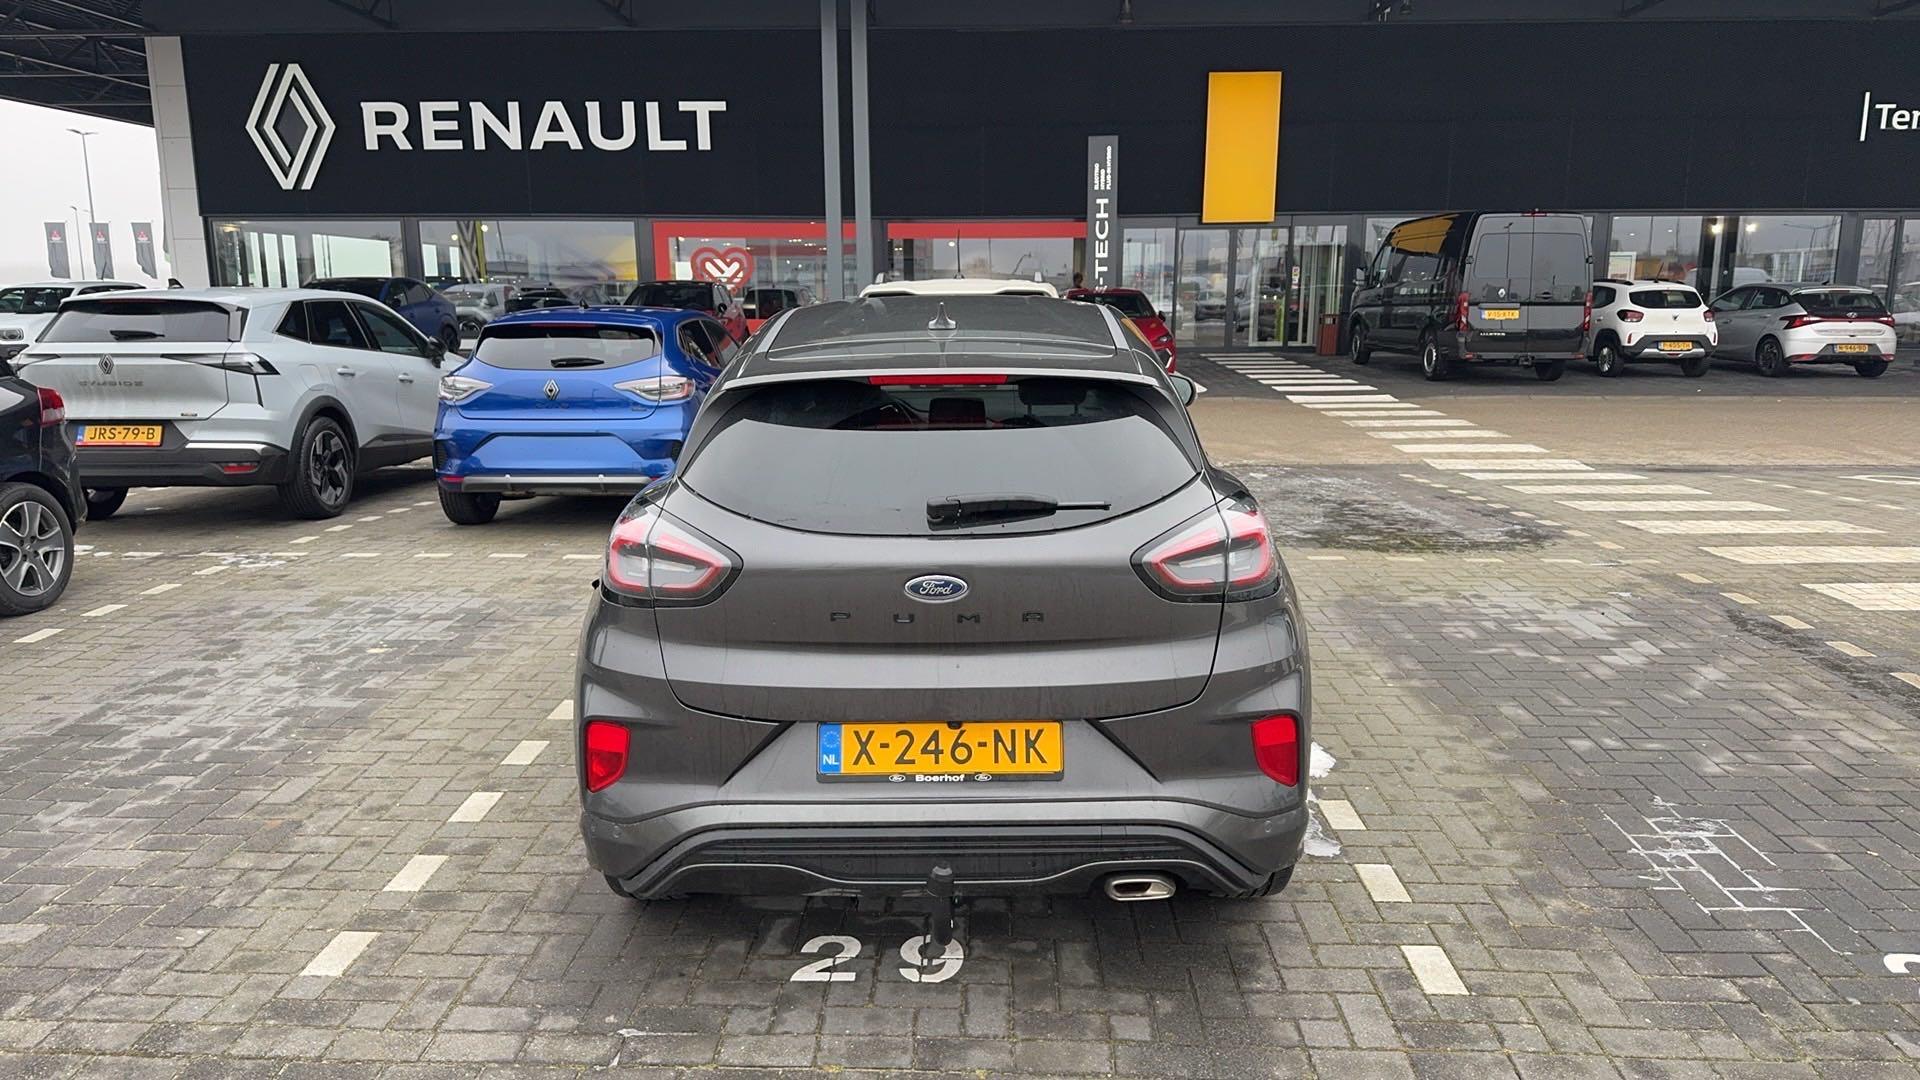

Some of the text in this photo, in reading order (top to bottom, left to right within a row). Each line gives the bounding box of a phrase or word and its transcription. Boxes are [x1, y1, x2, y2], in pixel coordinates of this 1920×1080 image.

[360, 101, 726, 151] RENAULT
[90, 428, 155, 440] JRS-79-B
[919, 580, 953, 595] Ford
[830, 612, 1044, 623] PUMA
[823, 729, 1048, 766] NL X-246-NK
[915, 773, 966, 782] Boerhof
